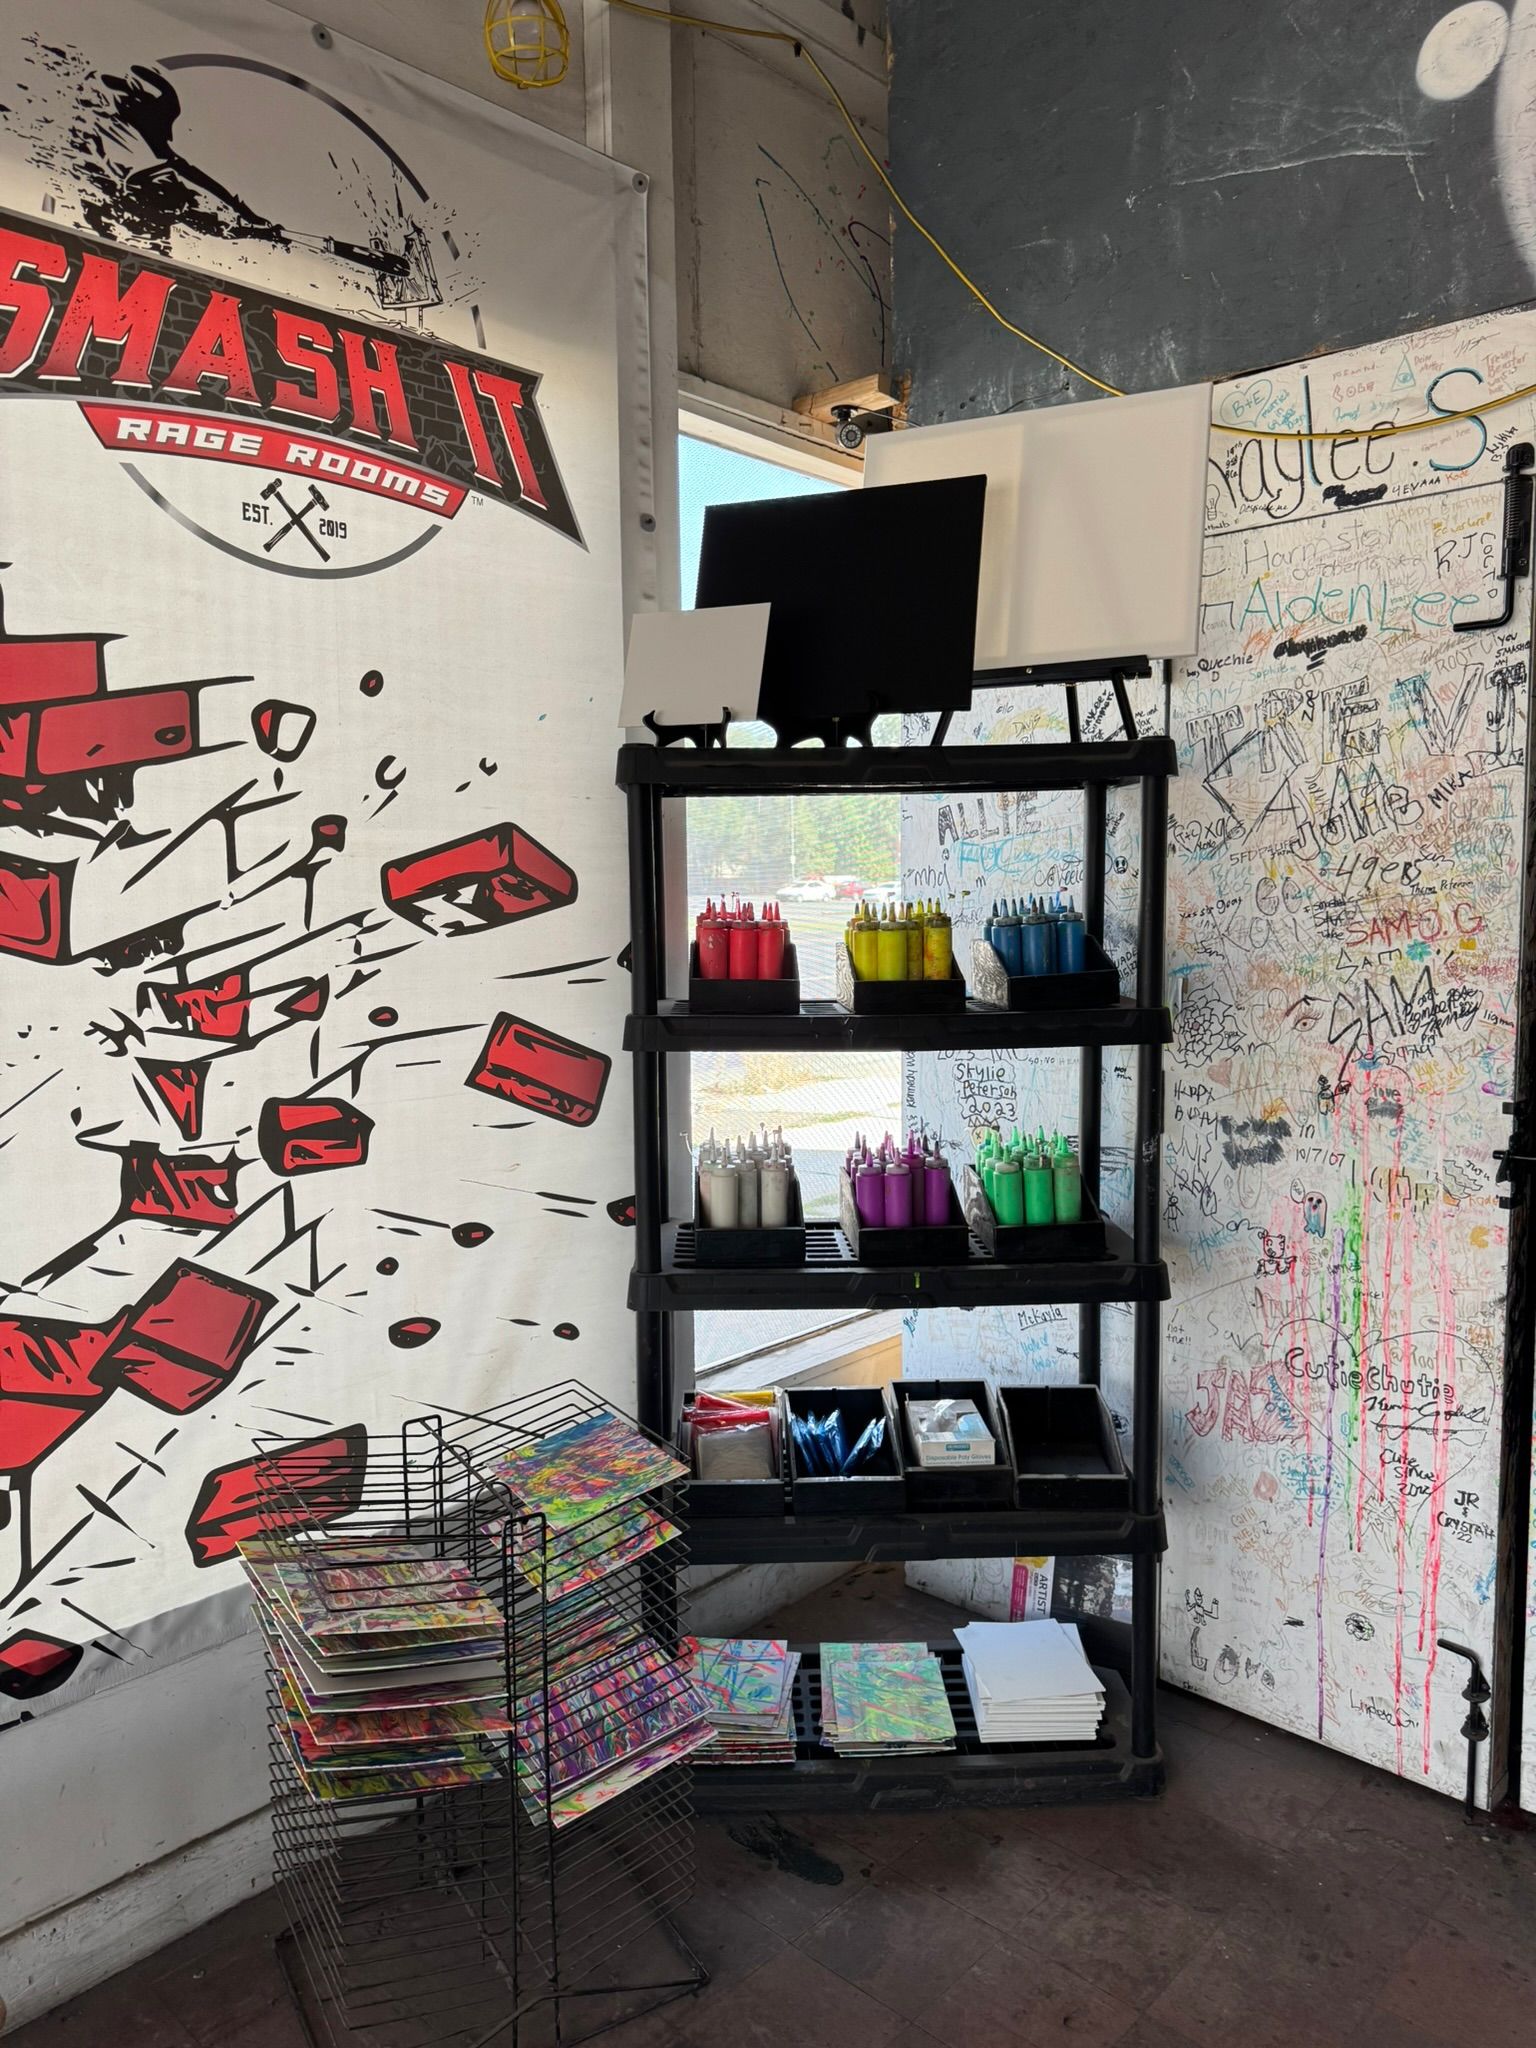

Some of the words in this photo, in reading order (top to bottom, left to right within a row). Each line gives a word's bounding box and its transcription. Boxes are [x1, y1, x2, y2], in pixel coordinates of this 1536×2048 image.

[0, 225, 419, 452] SMASH
[444, 360, 549, 511] IT
[117, 417, 264, 456] RAGE
[284, 442, 450, 507] ROOMS
[471, 495, 484, 506] TM
[242, 502, 273, 526] EST.
[319, 518, 347, 539] 2019
[966, 1096, 1017, 1118] 2023
[1295, 1147, 1347, 1168] 10/7/07
[1453, 1489, 1480, 1509] JR
[1036, 1573, 1049, 1615] ARTIST
